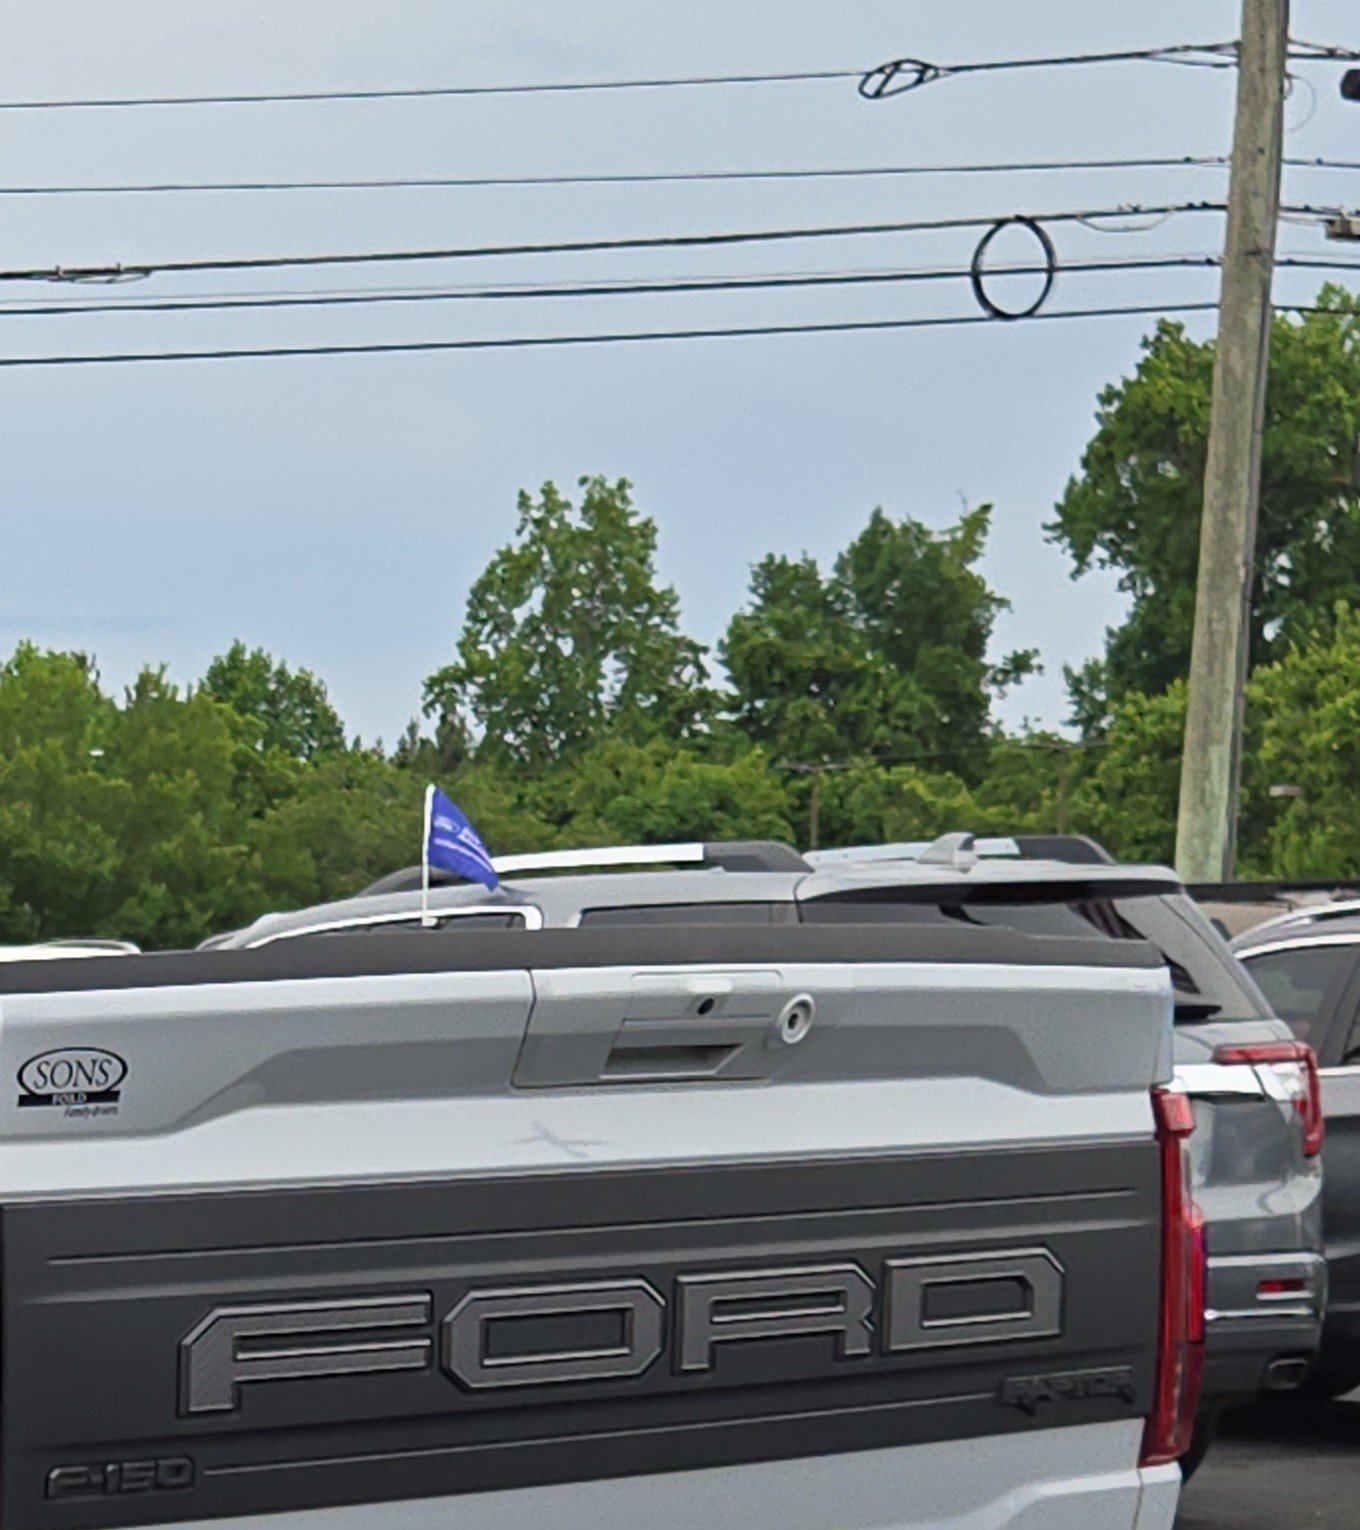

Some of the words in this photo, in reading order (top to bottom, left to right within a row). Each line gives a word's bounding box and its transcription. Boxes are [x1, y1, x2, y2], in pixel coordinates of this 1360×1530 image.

[33, 1058, 113, 1089] SONS
[176, 1245, 1067, 1417] FORD
[1003, 1366, 1136, 1416] RAPTOR
[46, 1454, 195, 1499] F-150
